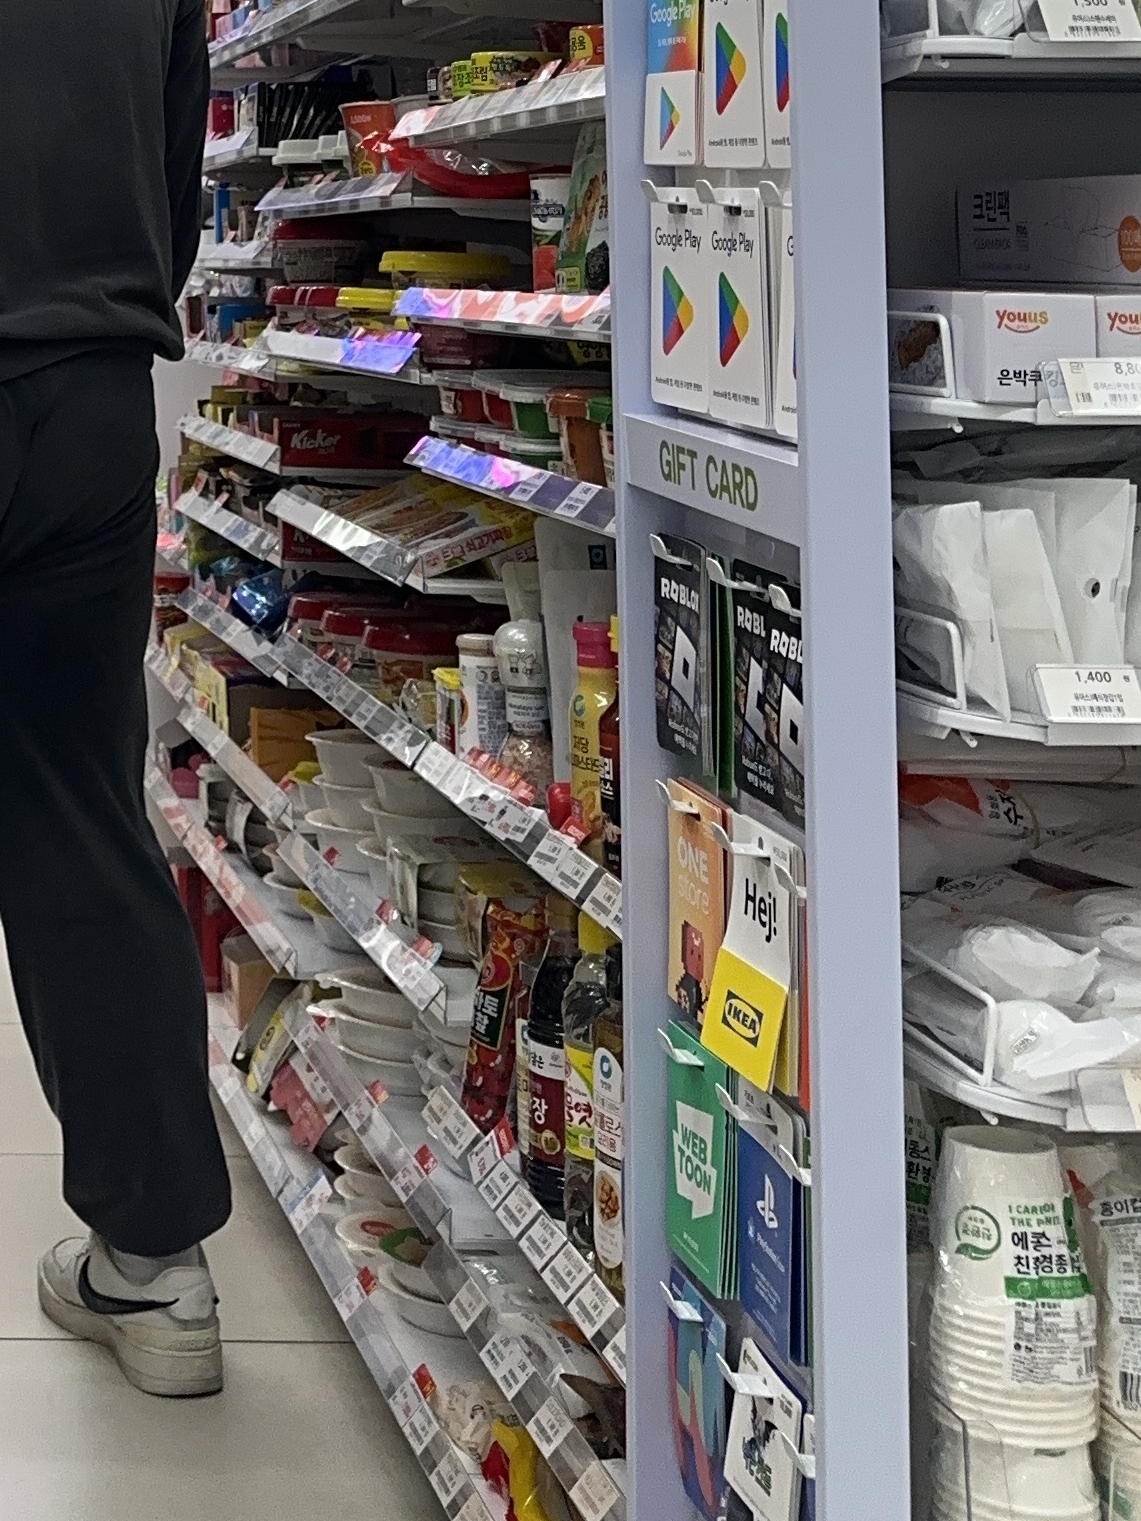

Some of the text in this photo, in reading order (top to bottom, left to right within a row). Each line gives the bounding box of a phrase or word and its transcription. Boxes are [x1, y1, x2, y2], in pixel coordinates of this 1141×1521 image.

[650, 0, 677, 27] Google
[972, 189, 1010, 223] 크린팩
[655, 226, 702, 254] Google Play
[712, 230, 754, 258] Google Play
[995, 308, 1049, 329] youus
[1107, 311, 1141, 332] you
[1114, 361, 1141, 376] 8,80
[659, 439, 759, 513] GIFT CARD
[737, 605, 766, 638] ROBL
[769, 628, 803, 664] ROBL
[1074, 670, 1112, 684] 1,400
[677, 835, 710, 885] ONE
[677, 874, 710, 915] store
[743, 877, 778, 943] Hej!
[727, 1002, 758, 1035] IKEA
[532, 1096, 549, 1125] 장
[680, 1123, 708, 1165] WEB
[677, 1144, 712, 1196] TOON
